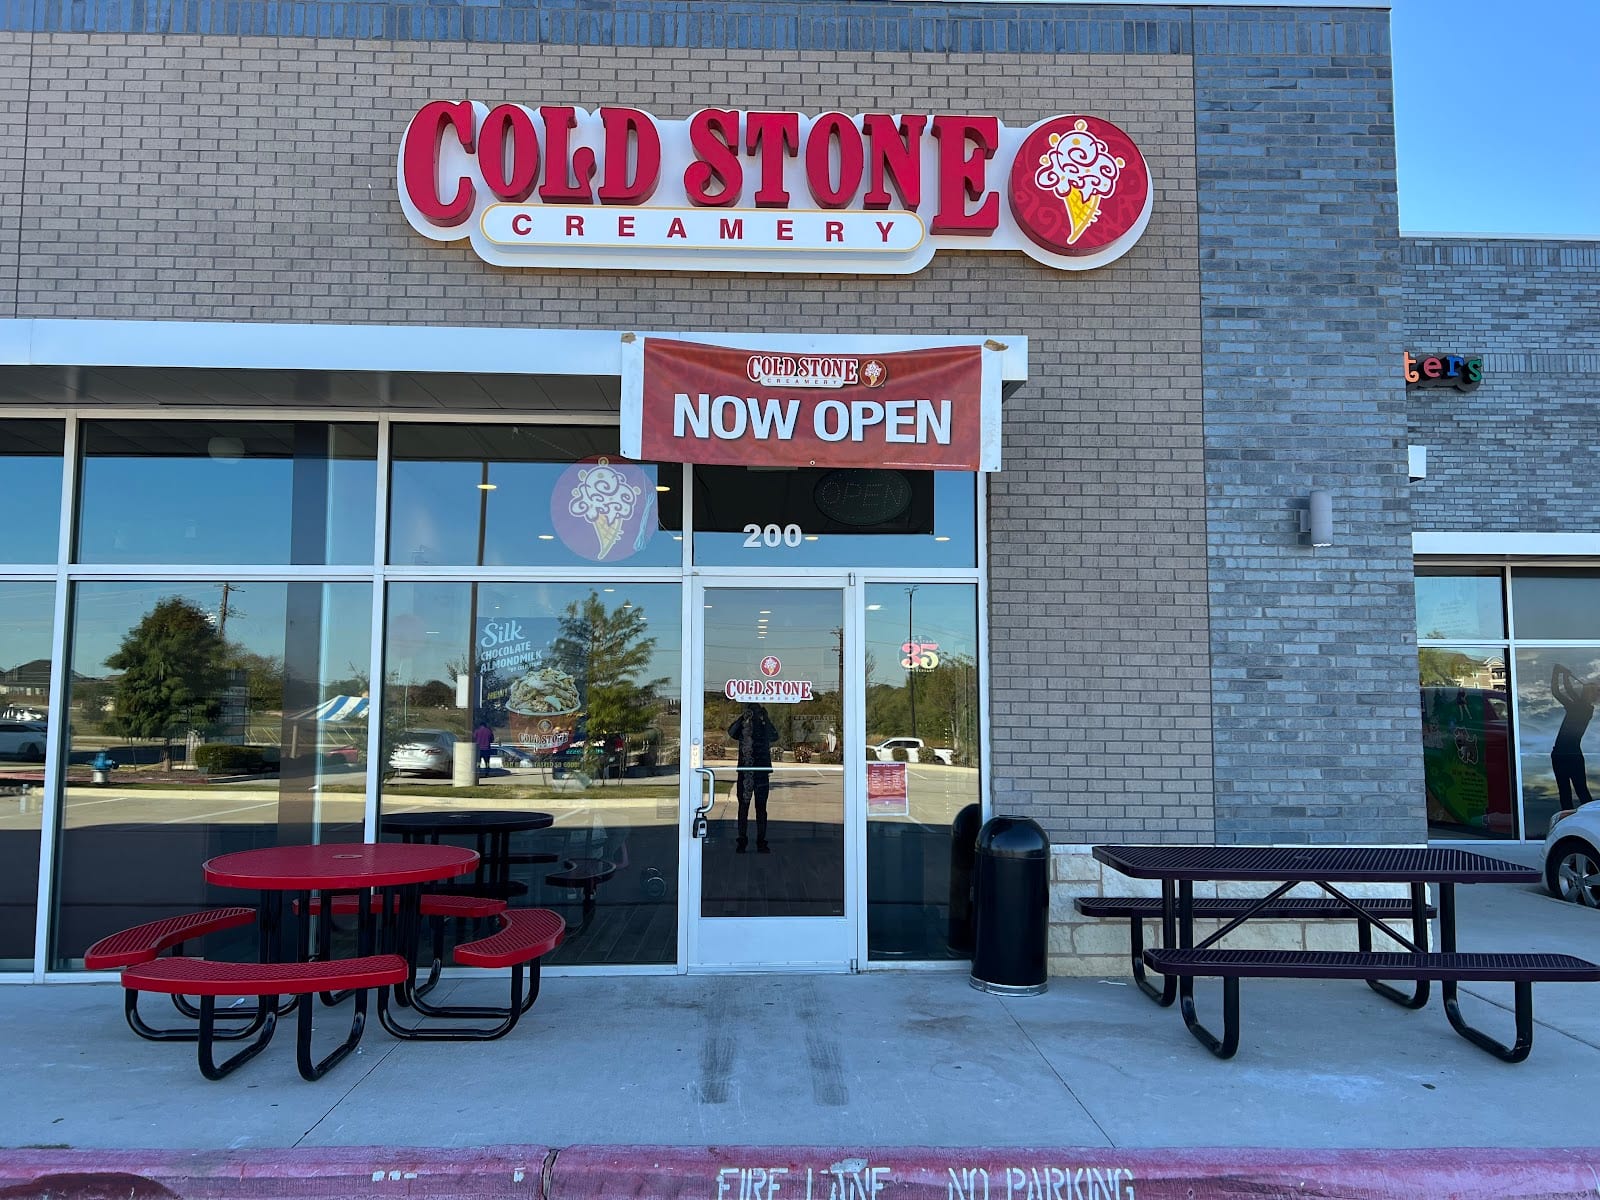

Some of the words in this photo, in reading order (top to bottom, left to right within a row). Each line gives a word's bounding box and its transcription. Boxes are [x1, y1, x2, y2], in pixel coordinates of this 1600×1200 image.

[403, 100, 661, 227] COLD
[684, 107, 1000, 237] STONE
[511, 213, 896, 243] CREAMERY
[748, 356, 795, 380] COLD
[798, 358, 857, 382] STONE
[1403, 351, 1483, 383] ters
[673, 393, 801, 441] NOW
[813, 399, 952, 445] OPEN
[822, 481, 903, 506] OPEN
[743, 523, 802, 548] 200
[481, 619, 526, 648] Silk
[480, 650, 543, 673] ALMONDMILK
[481, 640, 532, 661] CHOCOLATE
[901, 642, 939, 669] 35
[726, 680, 763, 698] COLD
[765, 681, 811, 699] STONE
[948, 1167, 989, 1200] NO
[1006, 1167, 1136, 1200] PARKING
